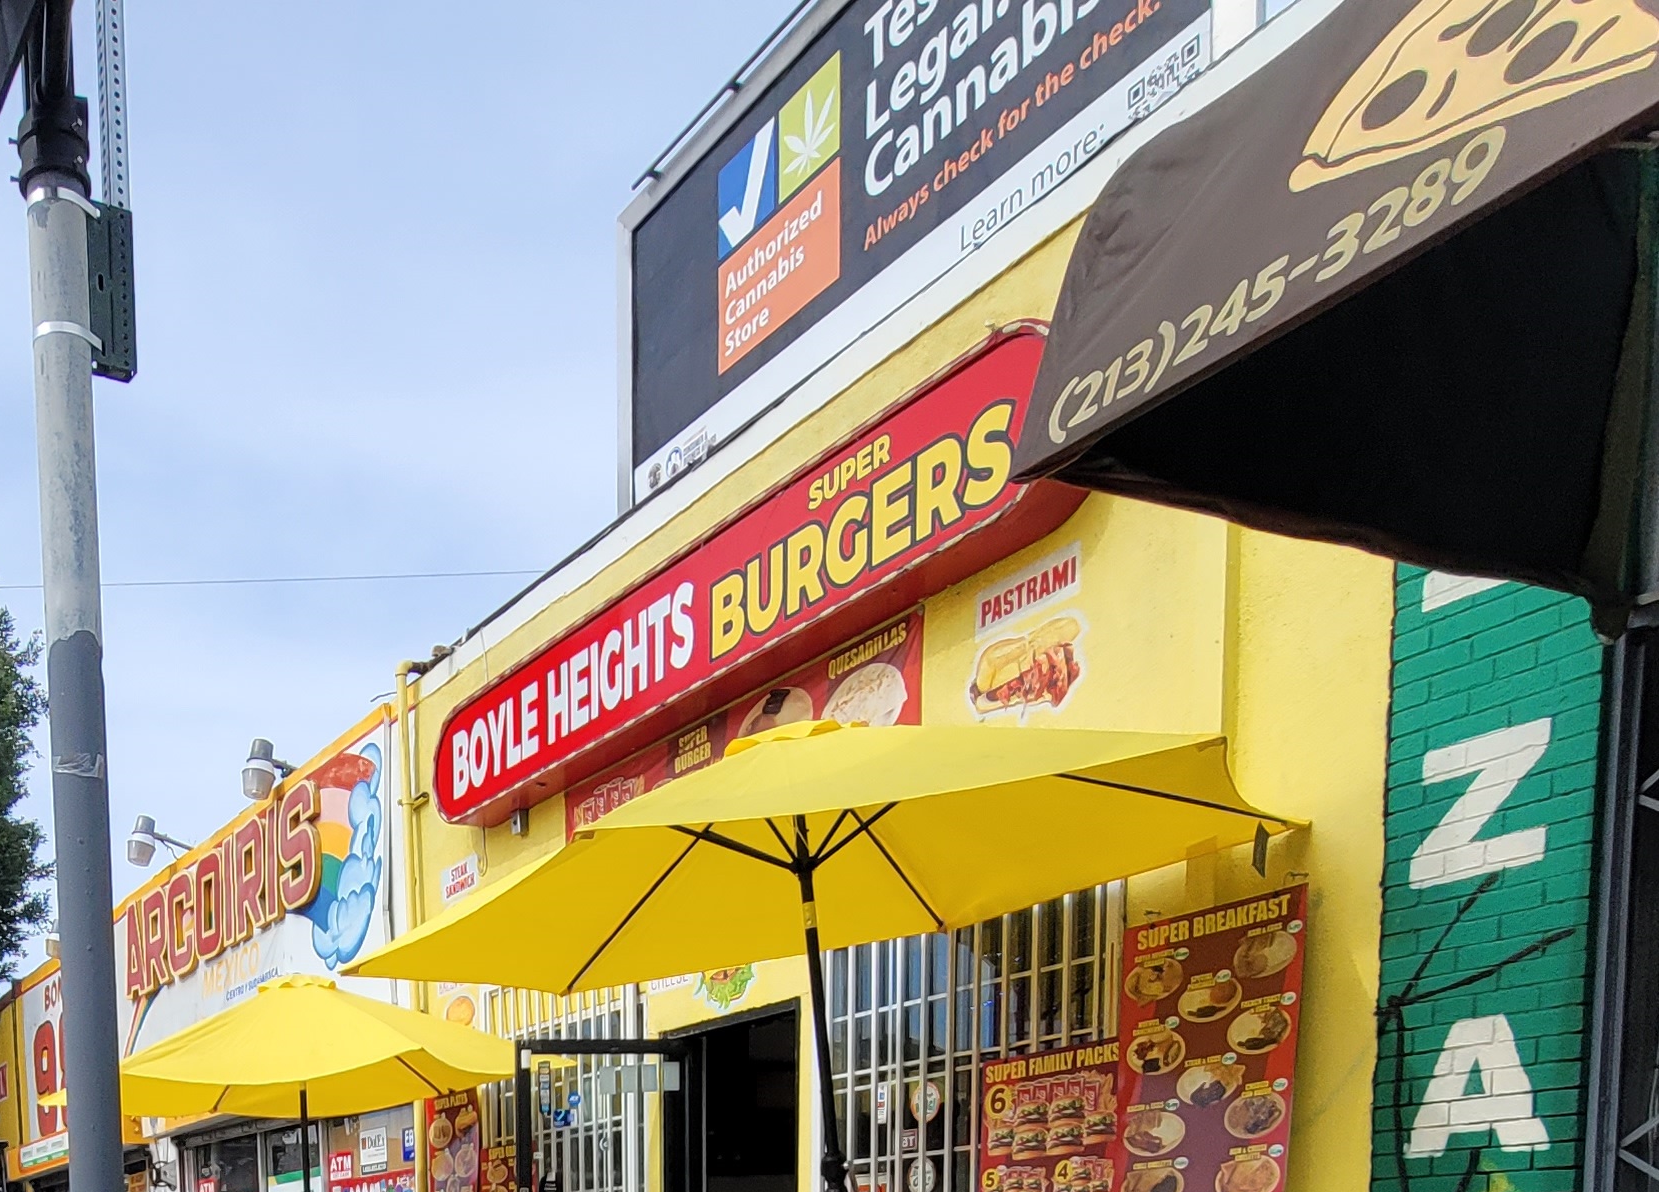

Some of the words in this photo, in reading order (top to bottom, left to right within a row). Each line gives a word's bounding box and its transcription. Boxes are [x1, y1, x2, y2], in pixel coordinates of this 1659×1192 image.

[863, 180, 931, 252] Always
[933, 128, 994, 193] check
[998, 97, 1031, 140] for
[1035, 62, 1075, 107] the
[1079, 0, 1162, 71] check.
[960, 188, 1022, 251] Learn
[1030, 122, 1106, 198] more:
[725, 190, 823, 297] Authorized
[725, 244, 805, 326] Cannabis
[1048, 125, 1507, 444] (213)245-3289
[725, 306, 770, 357] Store
[807, 433, 892, 511] SUPER
[452, 680, 539, 800] BOYLE
[547, 582, 694, 745] HEIGHTS
[710, 399, 1016, 662] BURGERS
[980, 555, 1077, 629] PASTRAMI
[827, 621, 908, 681] QUESADILLAS
[674, 742, 712, 774] BURGER
[125, 779, 322, 1001] ARCOIRIS
[445, 872, 476, 899] SANDWICH
[451, 861, 468, 882] STEAK
[1137, 920, 1190, 951] SUPER
[1192, 894, 1292, 938] BREAKFAST
[203, 941, 261, 999] MEXICO
[33, 1014, 68, 1137] 9
[985, 1060, 1027, 1084] SUPER
[1028, 1050, 1075, 1077] FAMILY
[1076, 1042, 1119, 1068] PACKS
[990, 1087, 1007, 1115] 6
[330, 1154, 352, 1172] ATM
[404, 1129, 414, 1147] EB
[902, 1135, 916, 1148] BT
[985, 1171, 995, 1188] 5
[1057, 1162, 1069, 1180] 4
